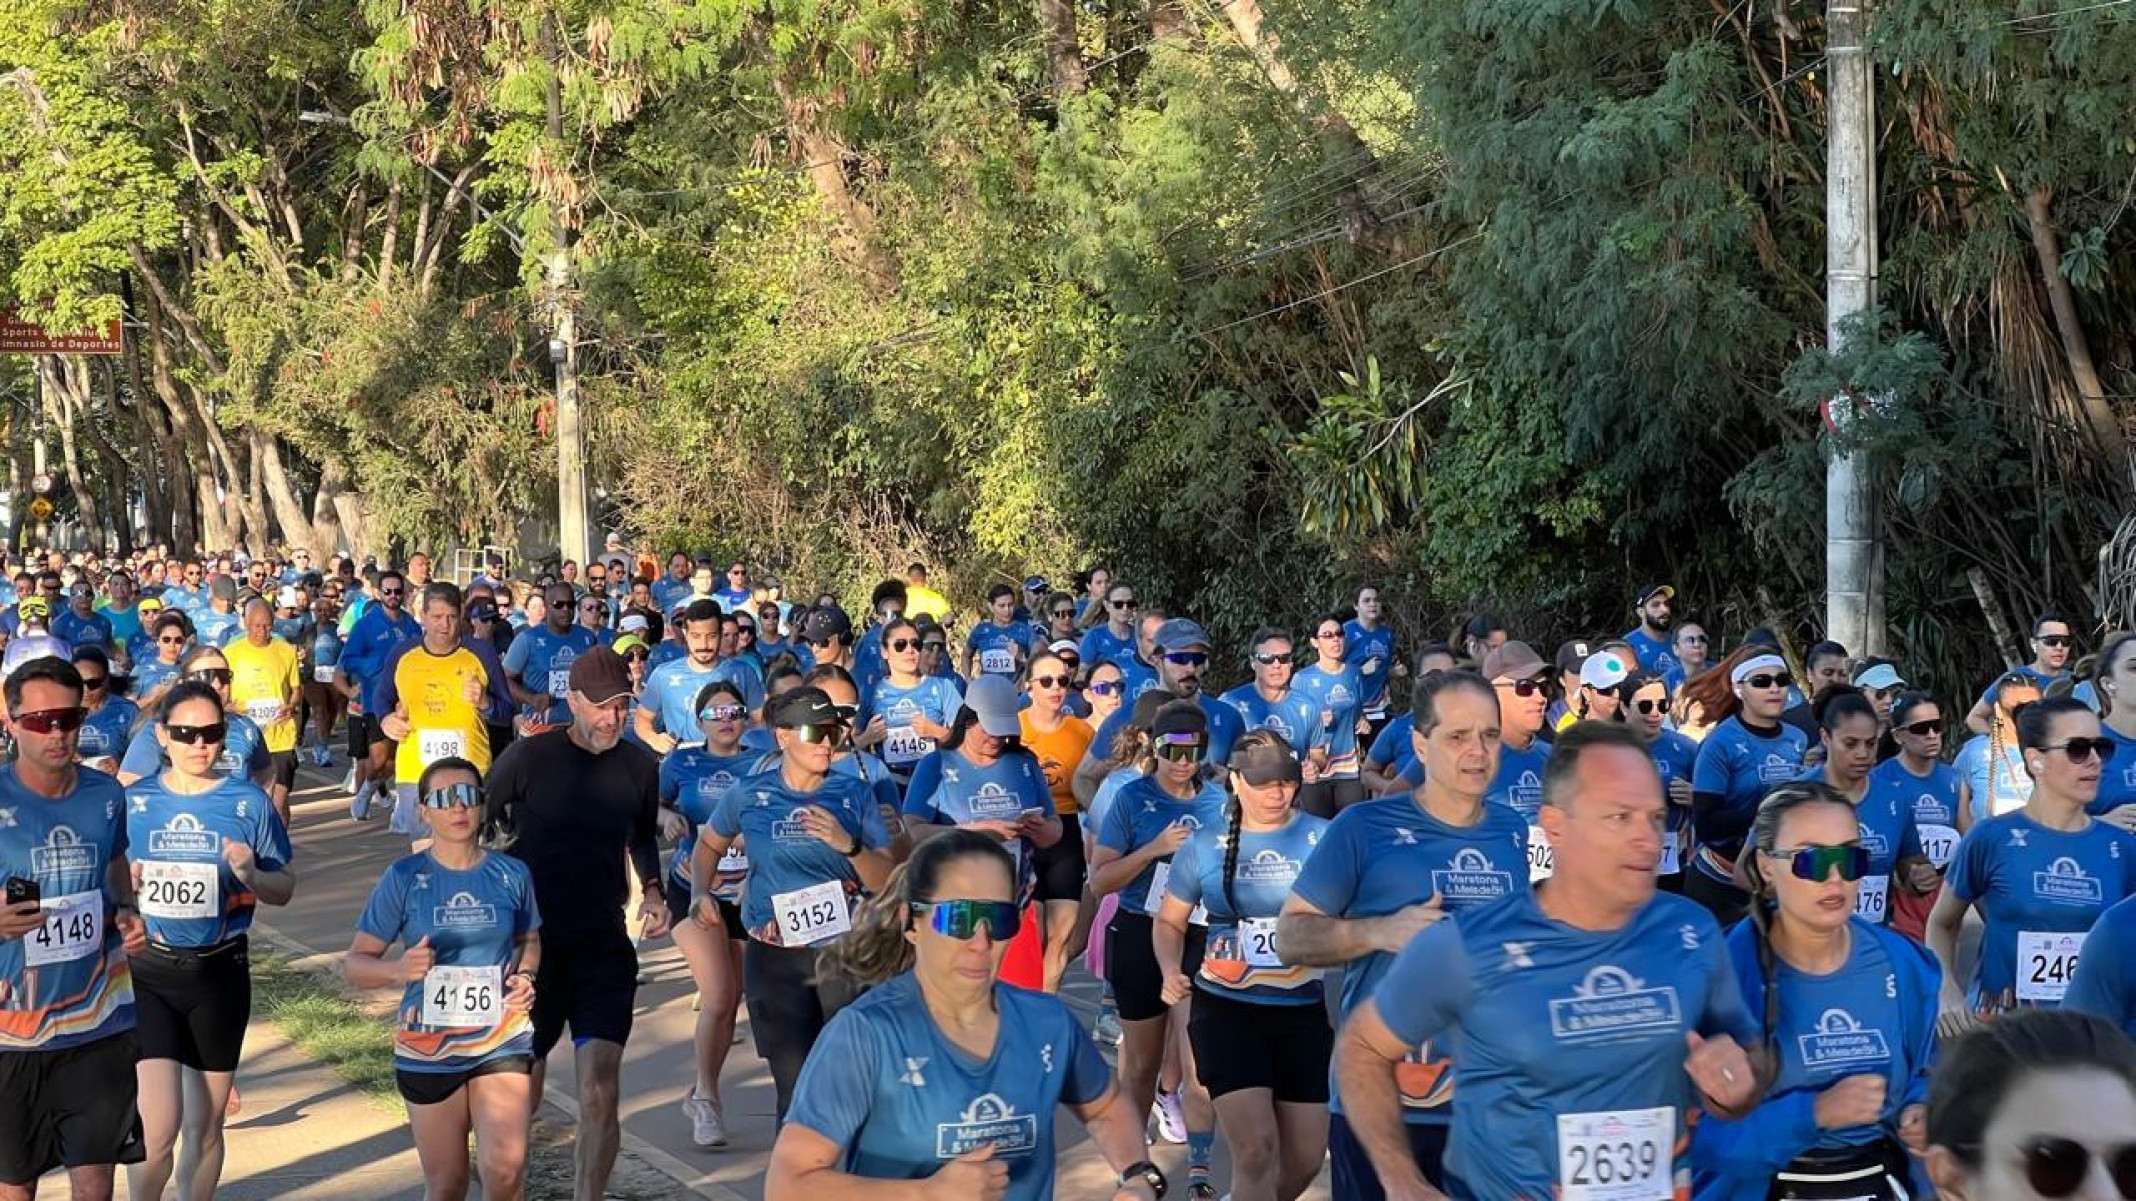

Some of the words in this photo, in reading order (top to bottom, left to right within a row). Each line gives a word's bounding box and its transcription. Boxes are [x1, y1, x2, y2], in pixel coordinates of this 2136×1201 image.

[51, 340, 64, 348] de
[68, 340, 120, 350] Deportes
[424, 741, 459, 757] 4198
[891, 738, 927, 753] 4146
[148, 881, 206, 904] 2062
[787, 901, 837, 931] 3152
[37, 912, 94, 947] 4148
[433, 985, 491, 1011] 4156
[1568, 1140, 1656, 1185] 2639
